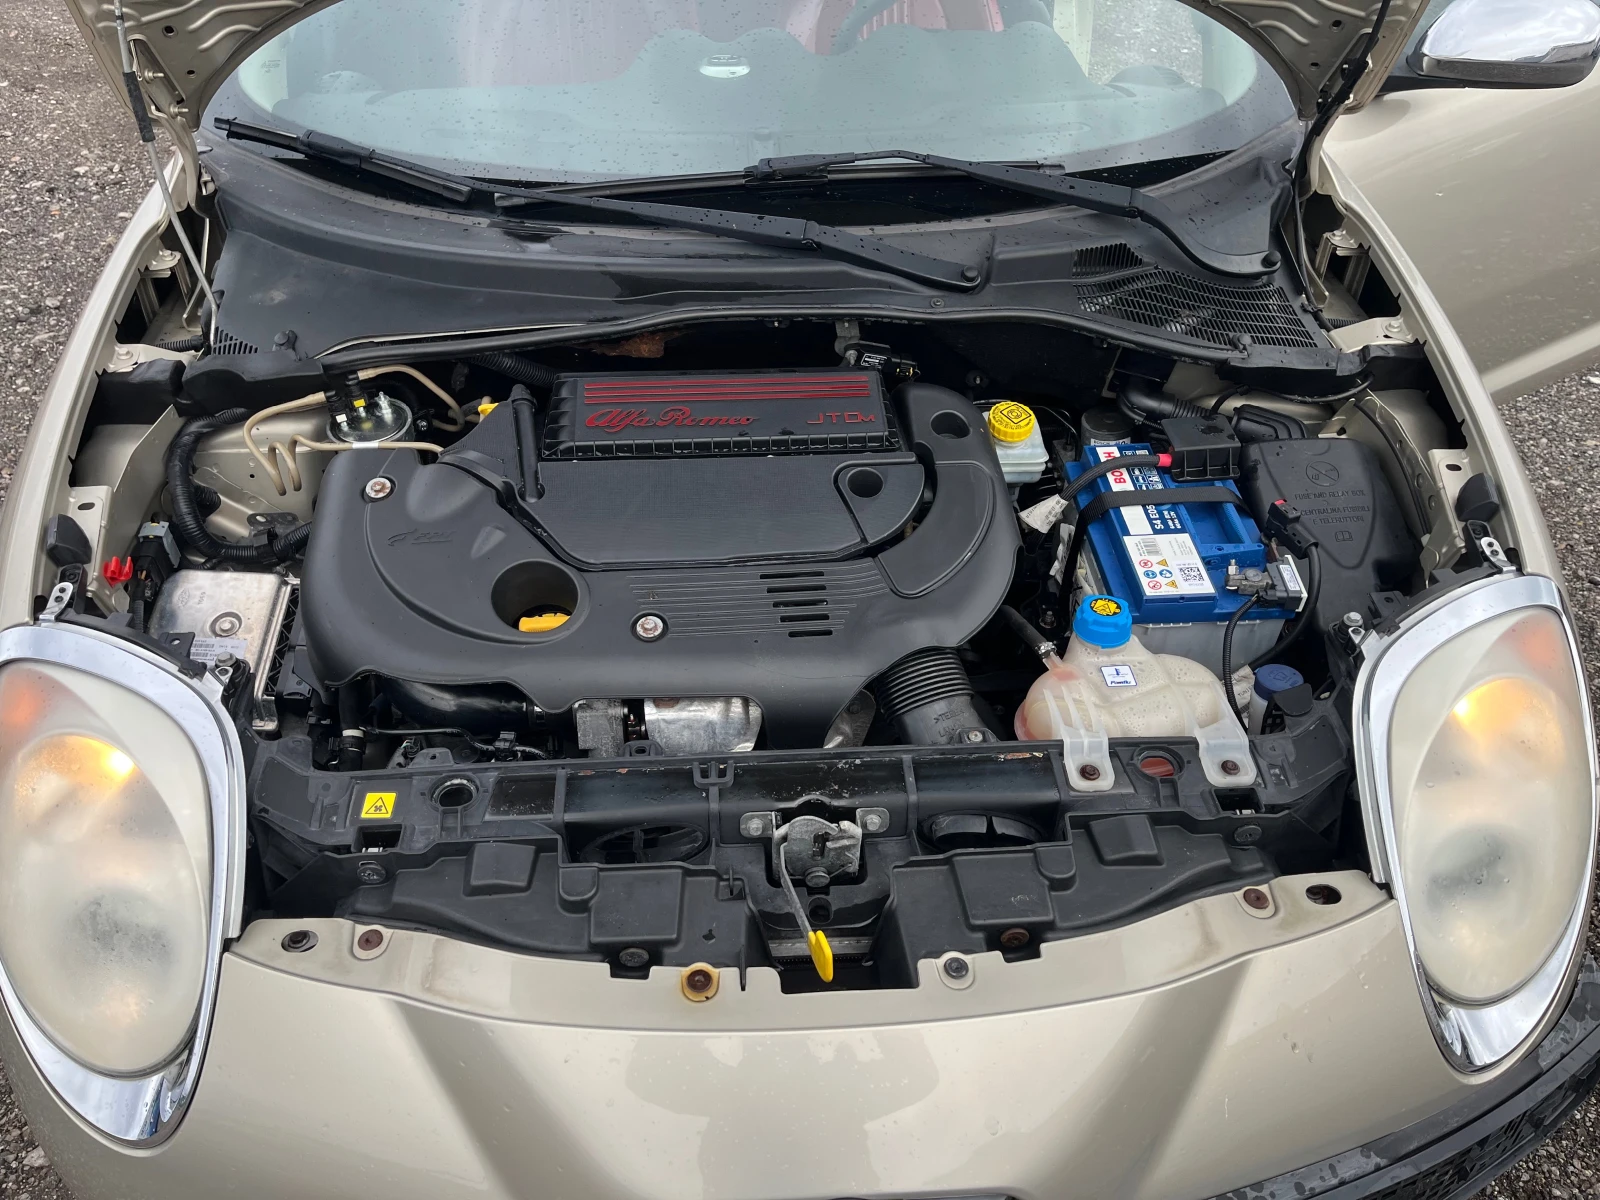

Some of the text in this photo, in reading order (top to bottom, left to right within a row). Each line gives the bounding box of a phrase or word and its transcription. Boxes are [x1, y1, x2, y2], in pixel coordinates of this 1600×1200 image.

[585, 405, 760, 433] Alfa Romeo
[1102, 451, 1127, 484] BOH
[1294, 492, 1312, 500] FUSE
[1146, 505, 1164, 529] S4 E05
